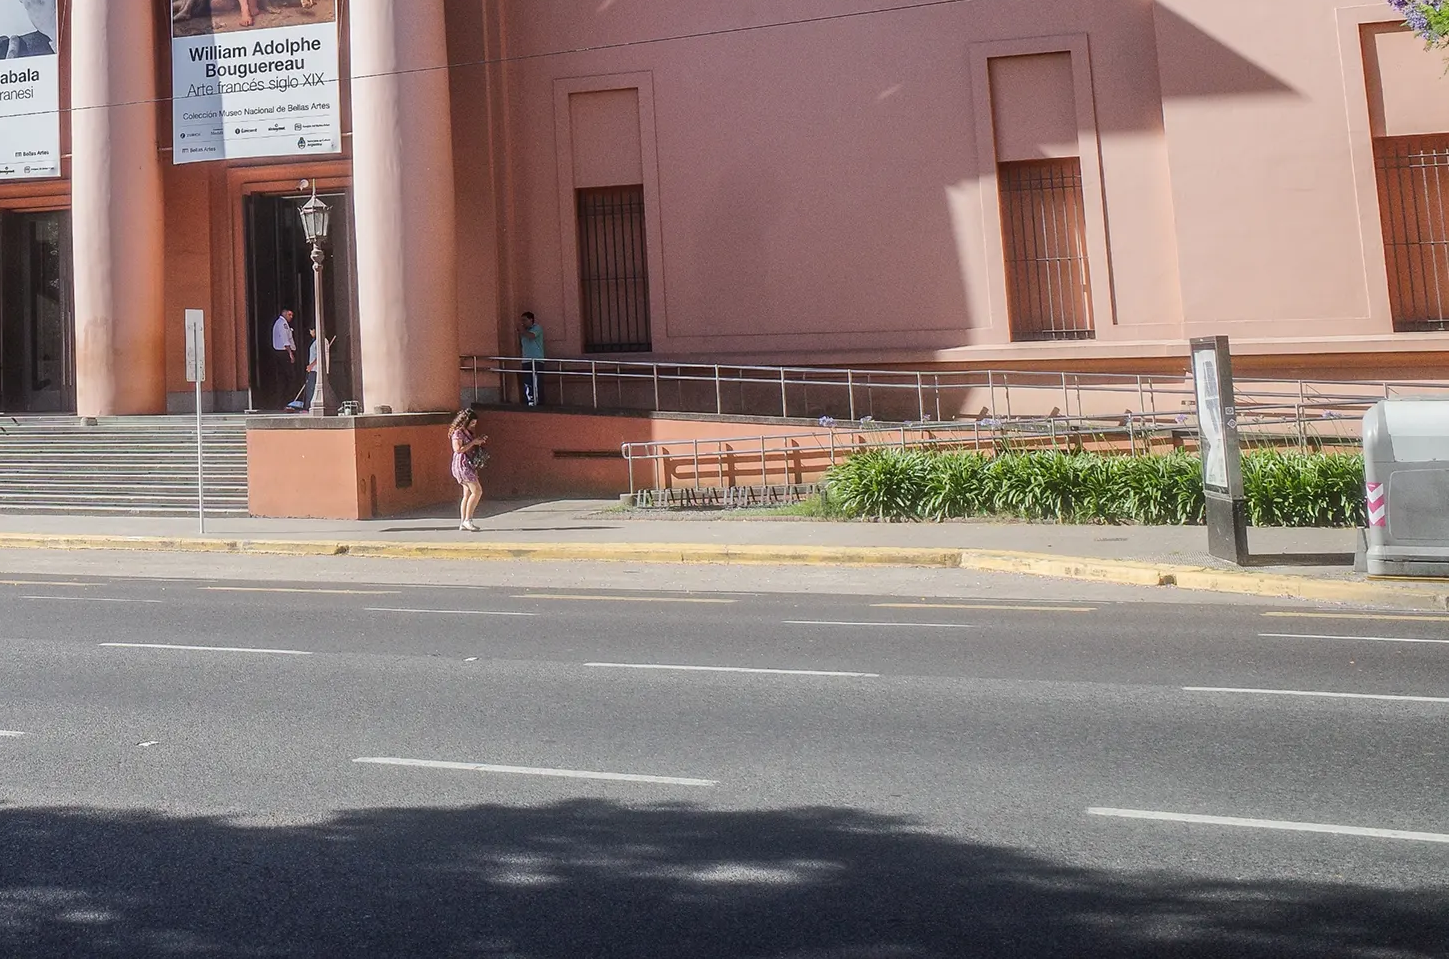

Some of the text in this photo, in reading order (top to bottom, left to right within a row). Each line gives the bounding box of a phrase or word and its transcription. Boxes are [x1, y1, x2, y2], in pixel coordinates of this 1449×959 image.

[189, 36, 322, 62] William Adolphe
[205, 58, 305, 78] Bouguereau
[187, 72, 325, 98] Arte francés siglo XIX
[183, 102, 331, 120] Colección Museo Nacional de Bellas Artes
